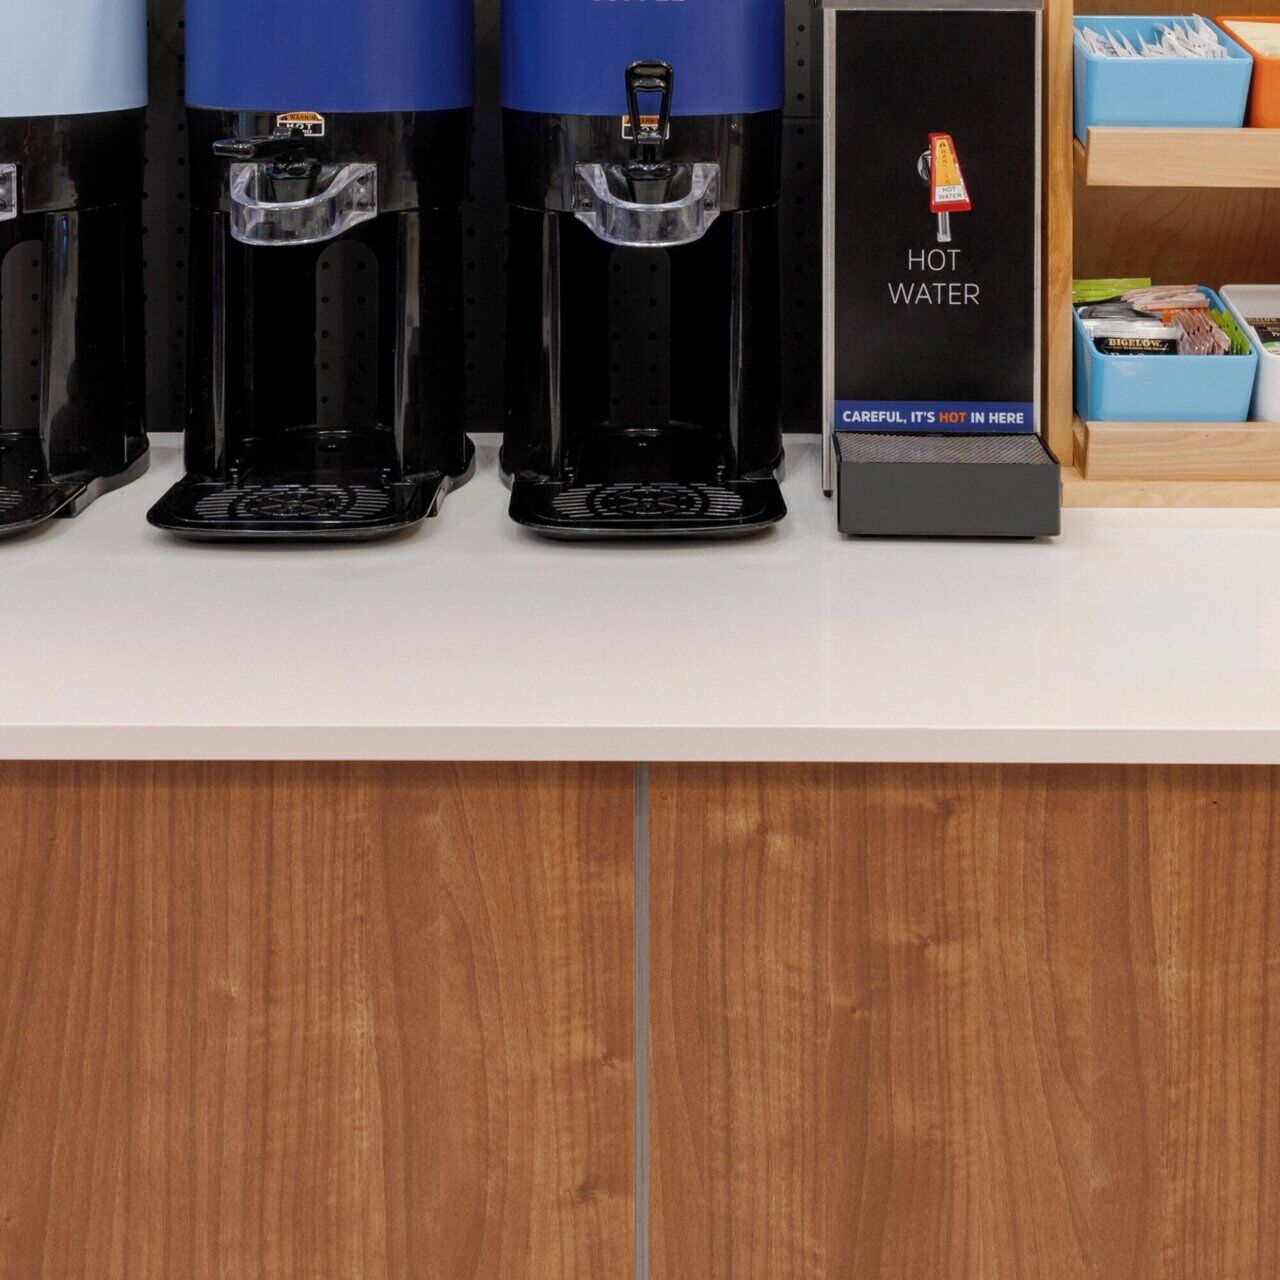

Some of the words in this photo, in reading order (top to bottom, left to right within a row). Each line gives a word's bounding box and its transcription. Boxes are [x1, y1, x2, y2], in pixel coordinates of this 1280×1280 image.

[908, 248, 961, 271] HOT
[887, 282, 980, 305] WATER
[842, 410, 908, 424] CAREFUL,
[911, 411, 936, 423] IT'S
[939, 411, 967, 424] HOT
[971, 412, 985, 424] IN
[988, 412, 1025, 424] HERE
